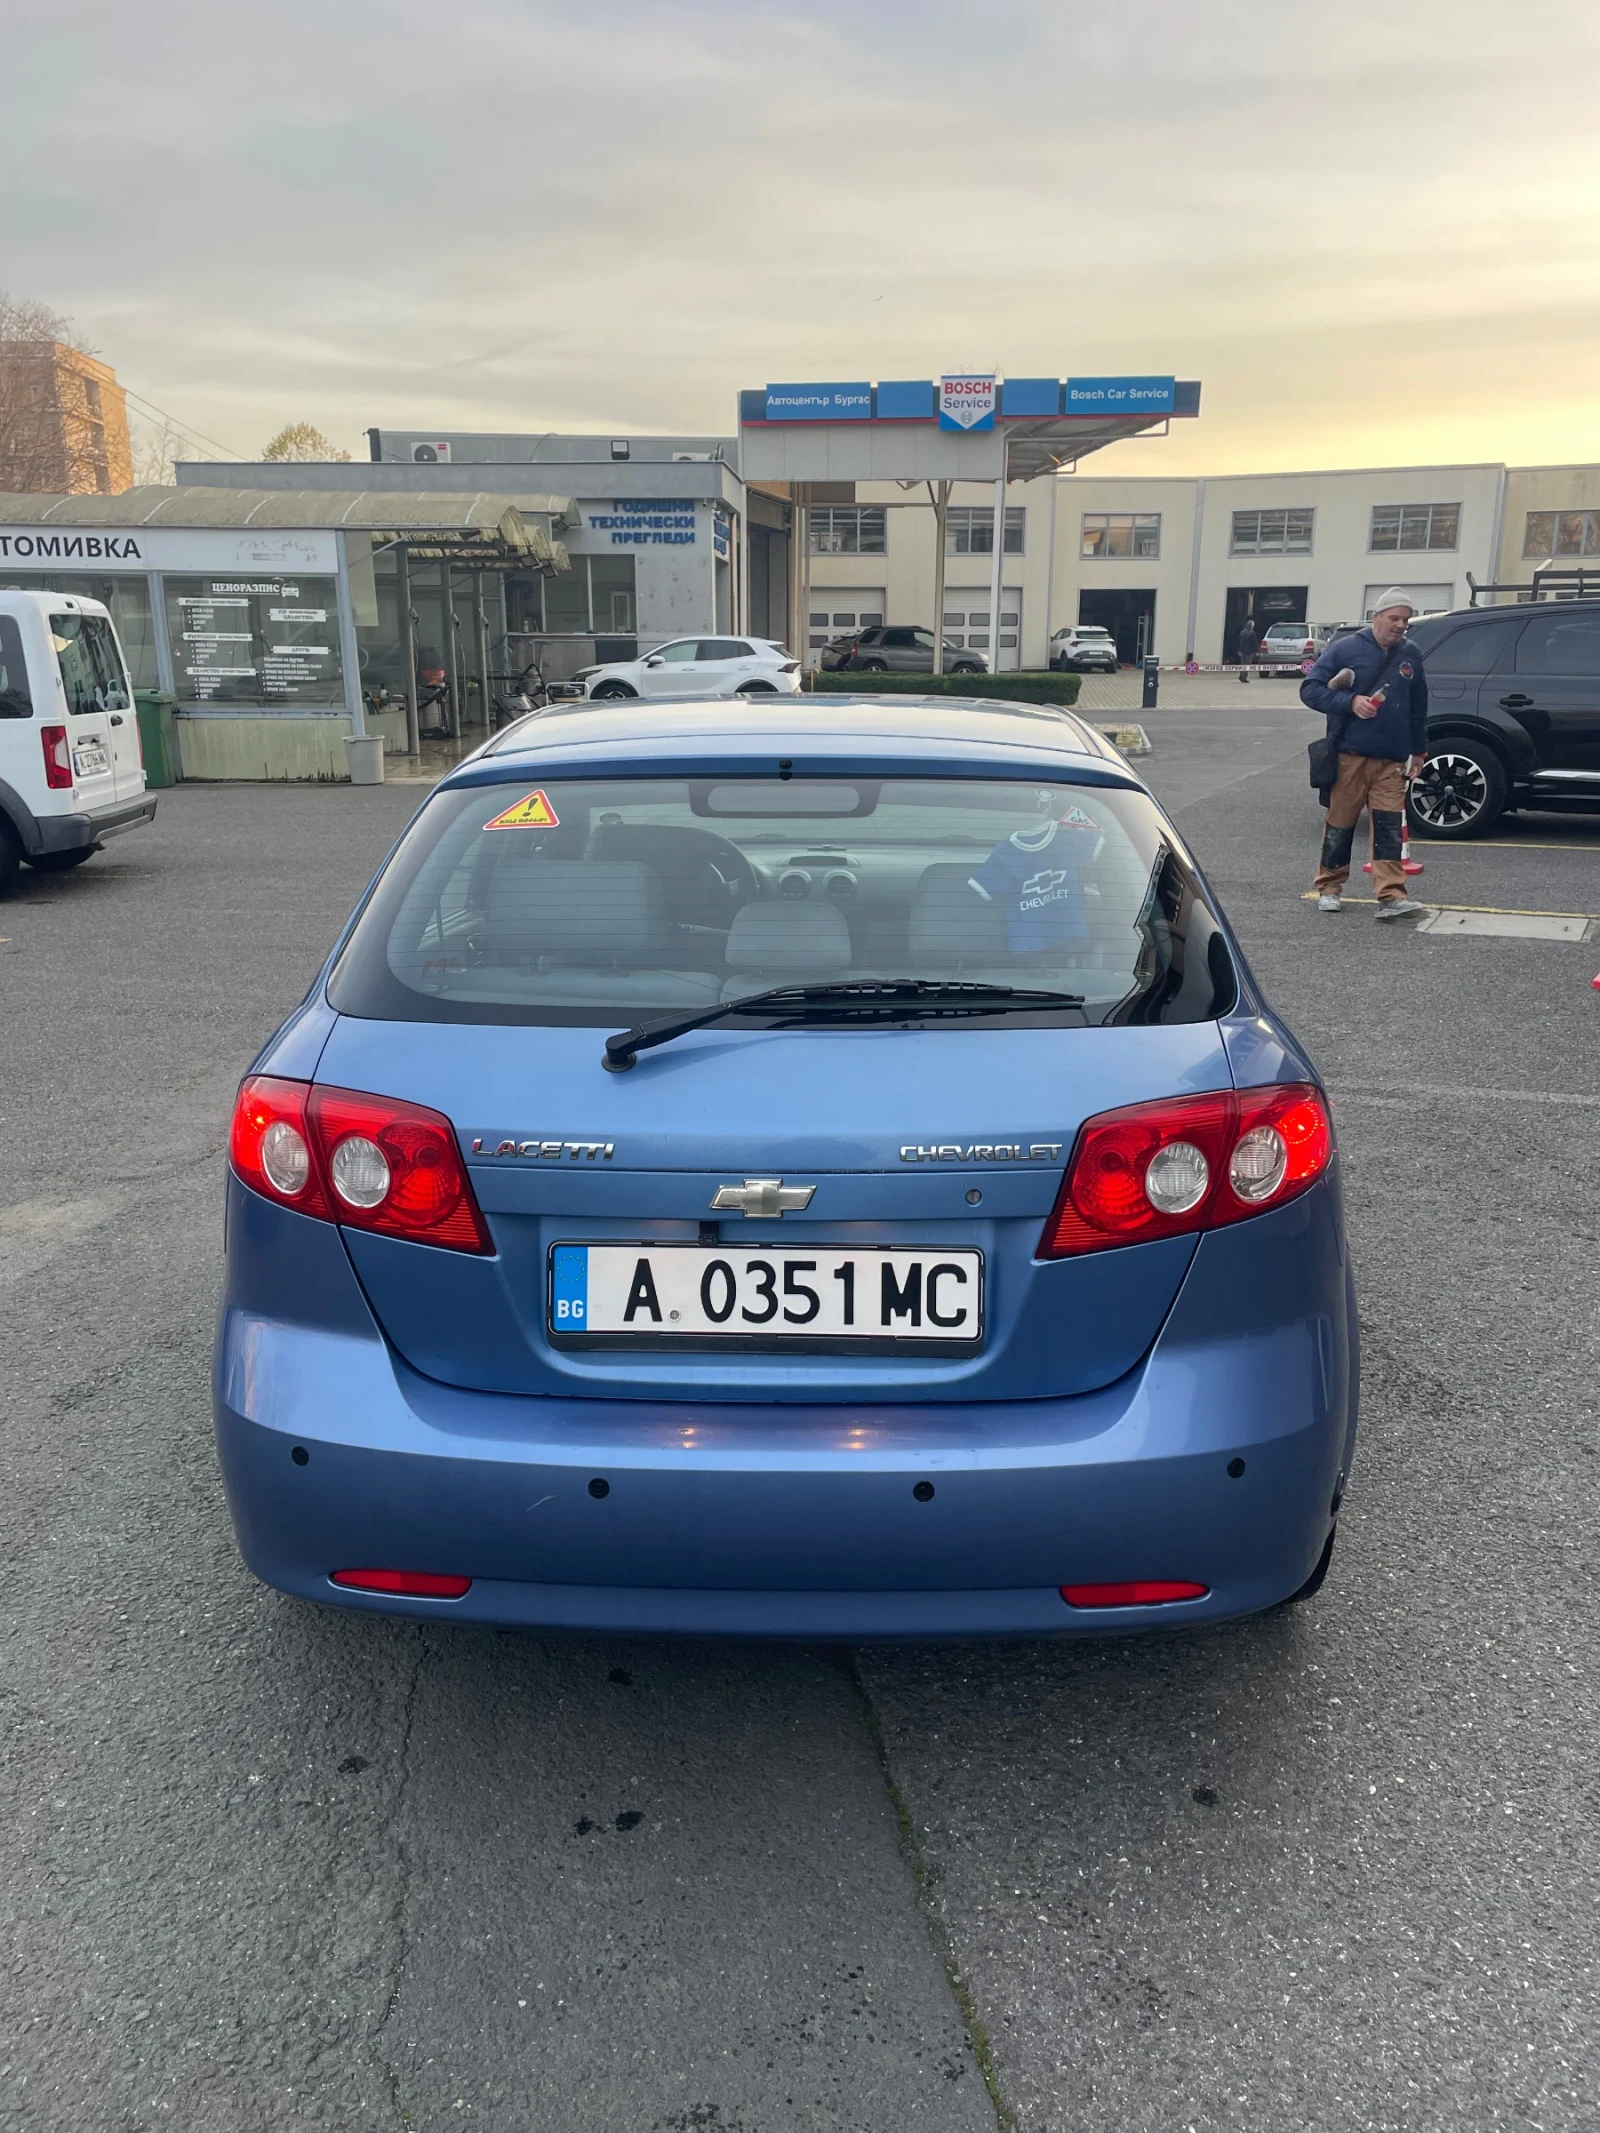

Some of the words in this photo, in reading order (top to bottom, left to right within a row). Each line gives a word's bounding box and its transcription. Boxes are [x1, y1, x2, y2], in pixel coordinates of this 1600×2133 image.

[944, 382, 992, 394] BOSCH
[1070, 390, 1104, 399] Bosch
[1107, 389, 1126, 399] Car
[1129, 388, 1169, 398] Service
[767, 395, 829, 407] Автоцентър
[834, 394, 870, 406] Бургас
[943, 397, 992, 409] Service
[613, 499, 695, 514] ГОДИШНИ
[589, 516, 695, 529] ТЕХНИЧЕСКИ
[611, 532, 695, 544] ПРЕГЛЕДИ
[212, 583, 280, 594] ЦЕНОРАЗПИС
[1070, 817, 1090, 825] GAS
[472, 1138, 615, 1161] LACETTI
[900, 1144, 1063, 1162] CHEVROLET
[623, 1258, 663, 1322] A
[700, 1259, 854, 1324] 0351
[881, 1262, 967, 1328] MC
[557, 1300, 584, 1318] BG
